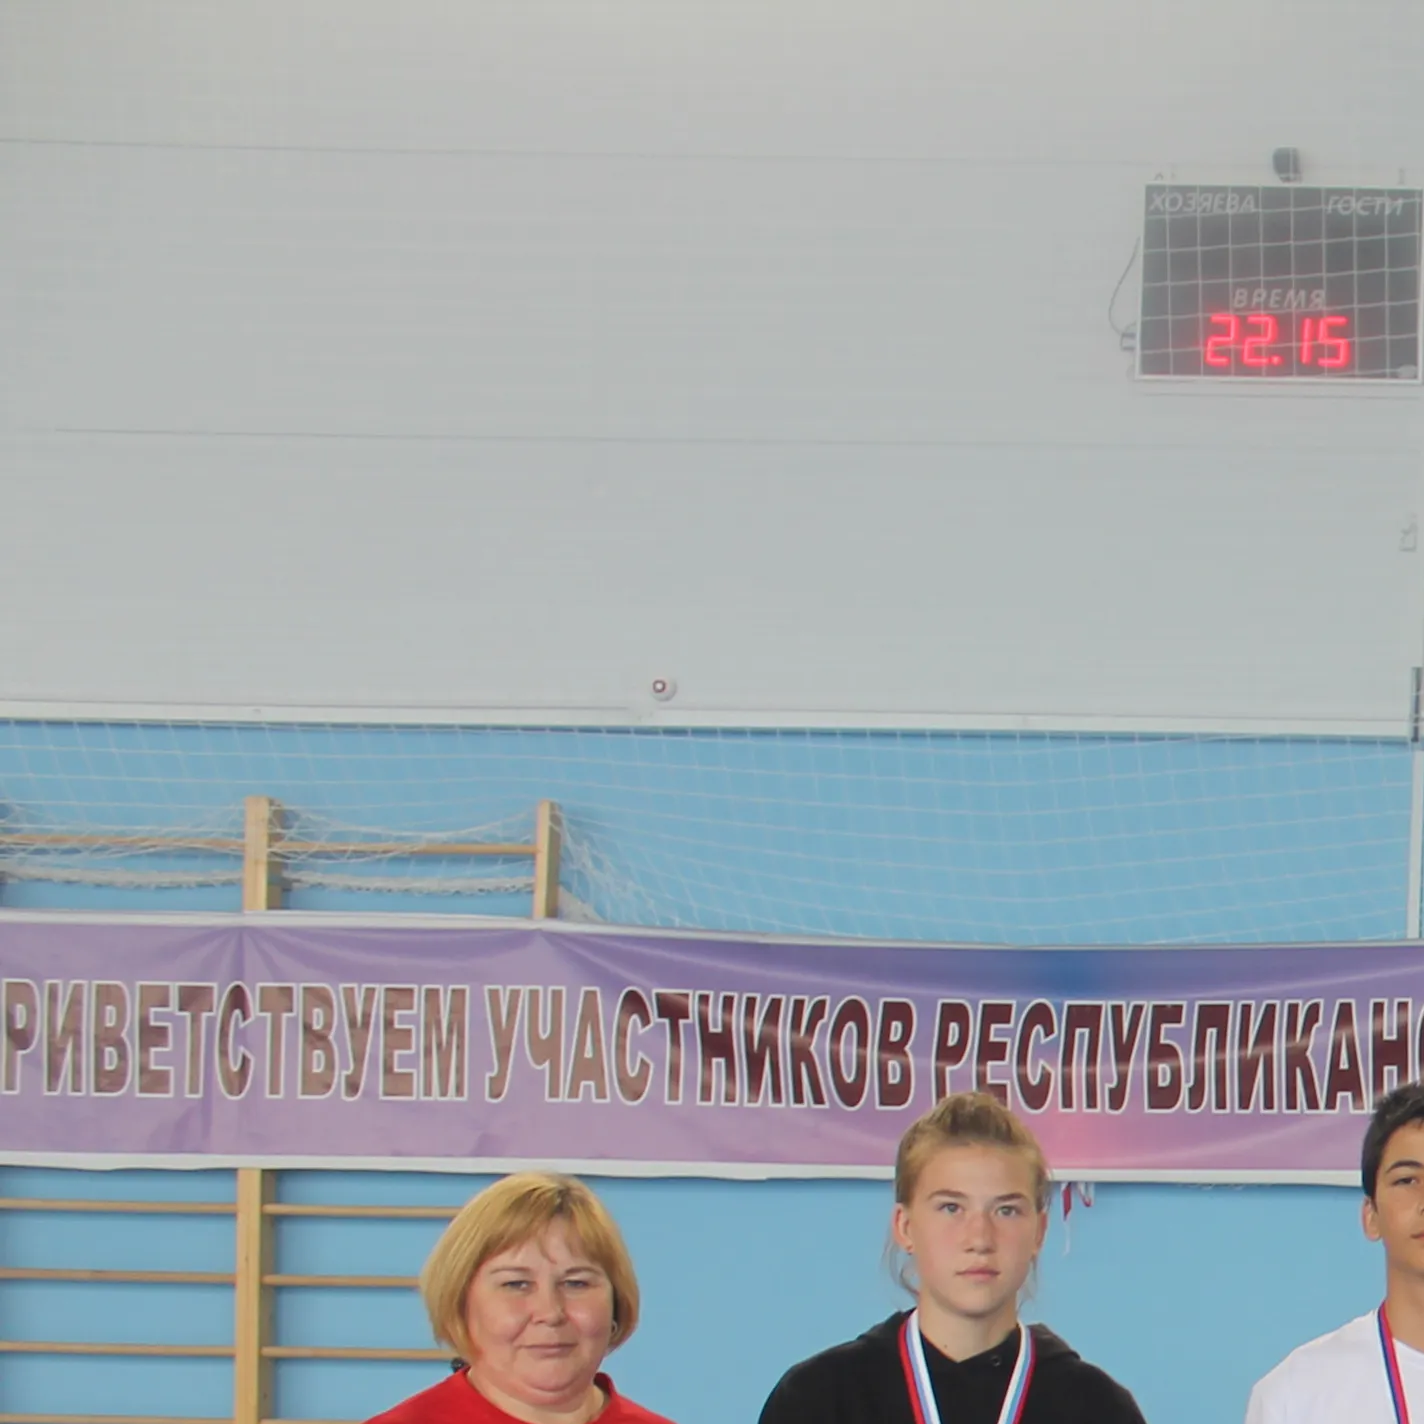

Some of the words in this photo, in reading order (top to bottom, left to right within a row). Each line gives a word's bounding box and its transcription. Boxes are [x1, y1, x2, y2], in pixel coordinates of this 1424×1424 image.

[1149, 192, 1258, 214] ХОЗЯЕВА
[1325, 195, 1404, 217] ГОСТИ
[1233, 288, 1327, 310] ВРЕМЯ
[1204, 313, 1350, 368] 22.15
[0, 977, 469, 1102] РИВЕТСТВУЕМ
[485, 985, 916, 1112] УЧАСТНИКОВ
